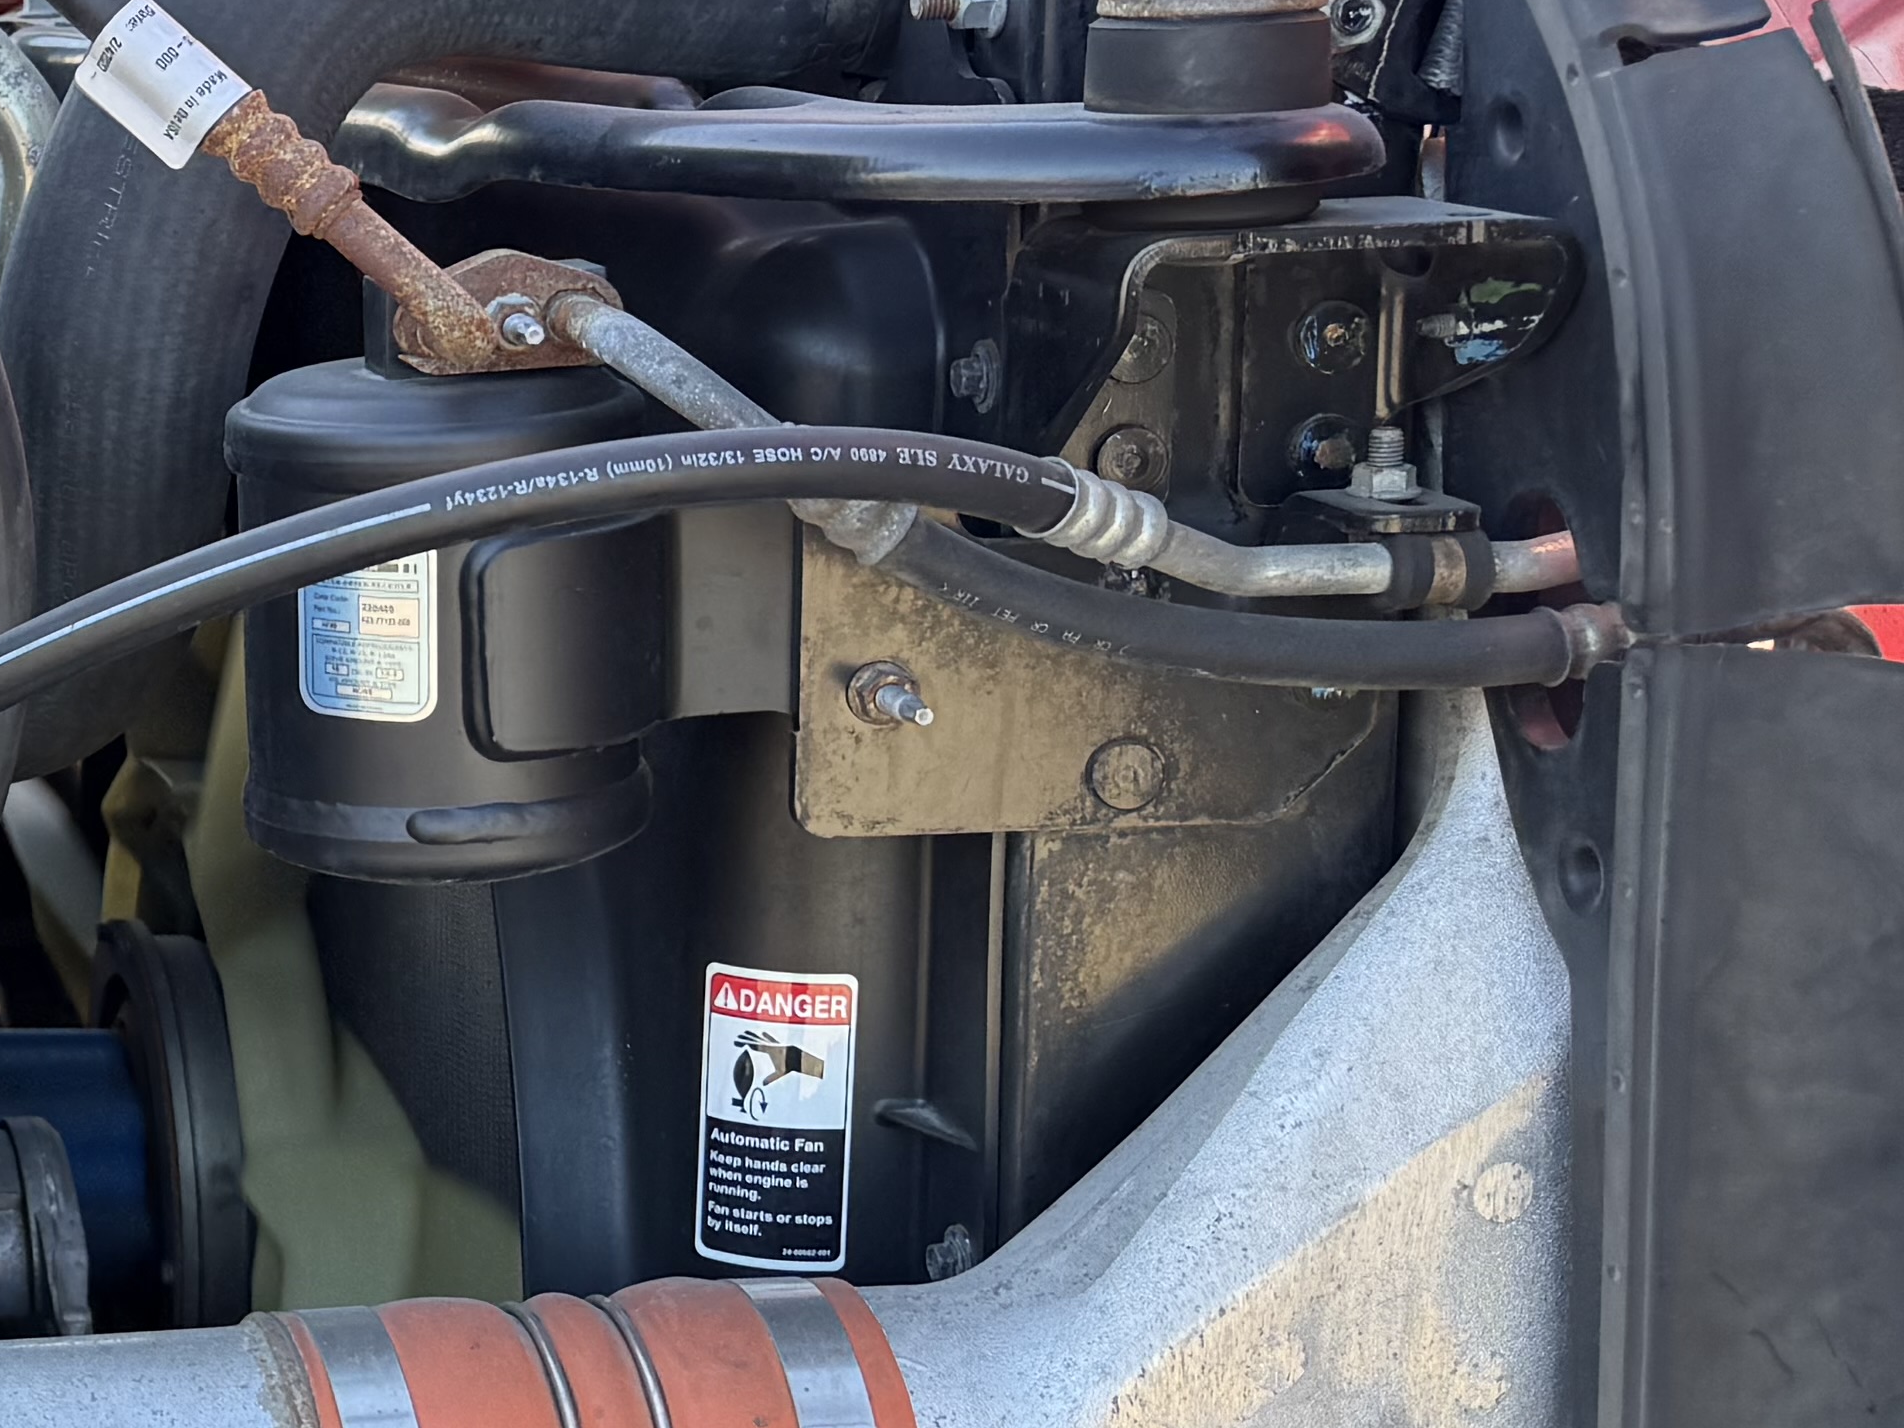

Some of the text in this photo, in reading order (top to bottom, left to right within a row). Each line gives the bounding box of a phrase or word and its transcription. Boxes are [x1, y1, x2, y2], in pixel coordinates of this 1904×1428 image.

[196, 70, 227, 97] Made
[186, 96, 200, 109] in
[682, 450, 745, 467] 13/32in
[753, 447, 802, 463] HOSE
[812, 447, 841, 461] A/C
[851, 447, 886, 463] 4890
[897, 447, 937, 467] SLE
[606, 453, 672, 479] (10mm)
[948, 453, 1030, 483] GALAXY
[740, 989, 847, 1018] DANGER
[711, 1128, 823, 1152] Automatic Fan
[710, 1150, 825, 1173] Keep hands clear
[709, 1167, 808, 1188] when engine is
[708, 1182, 761, 1201] running.
[708, 1200, 832, 1227] Fan starts or stops
[707, 1216, 761, 1236] by itself.
